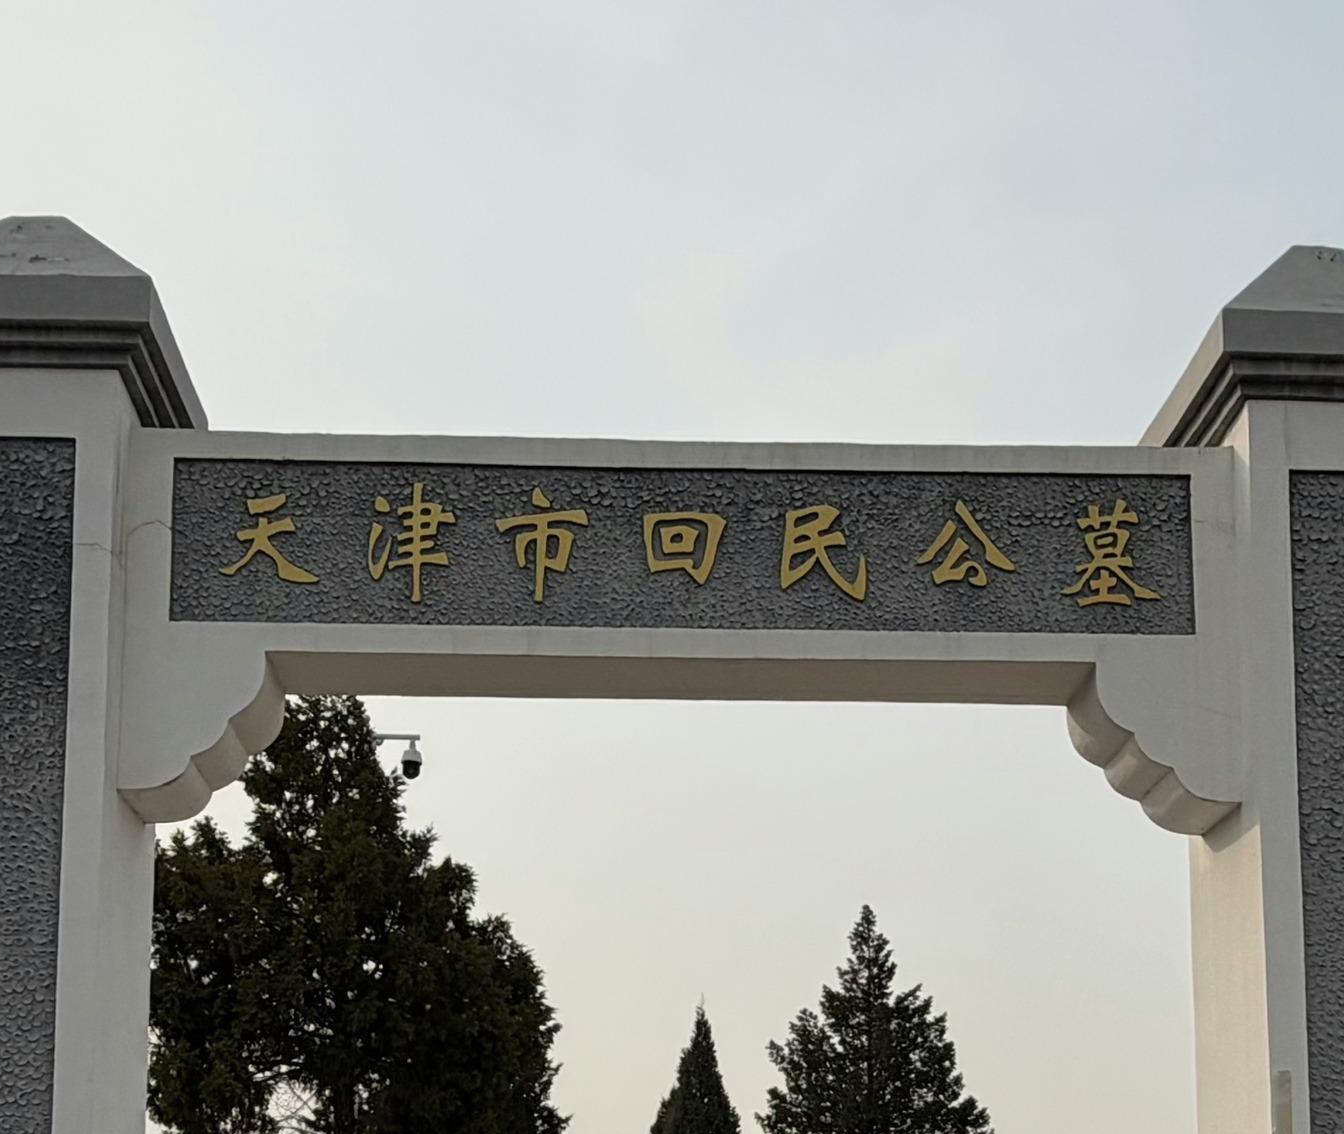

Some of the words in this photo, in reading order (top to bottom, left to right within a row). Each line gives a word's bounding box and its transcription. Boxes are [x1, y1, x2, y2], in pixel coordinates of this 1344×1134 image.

[218, 482, 1162, 607] 天津市回民公墓
